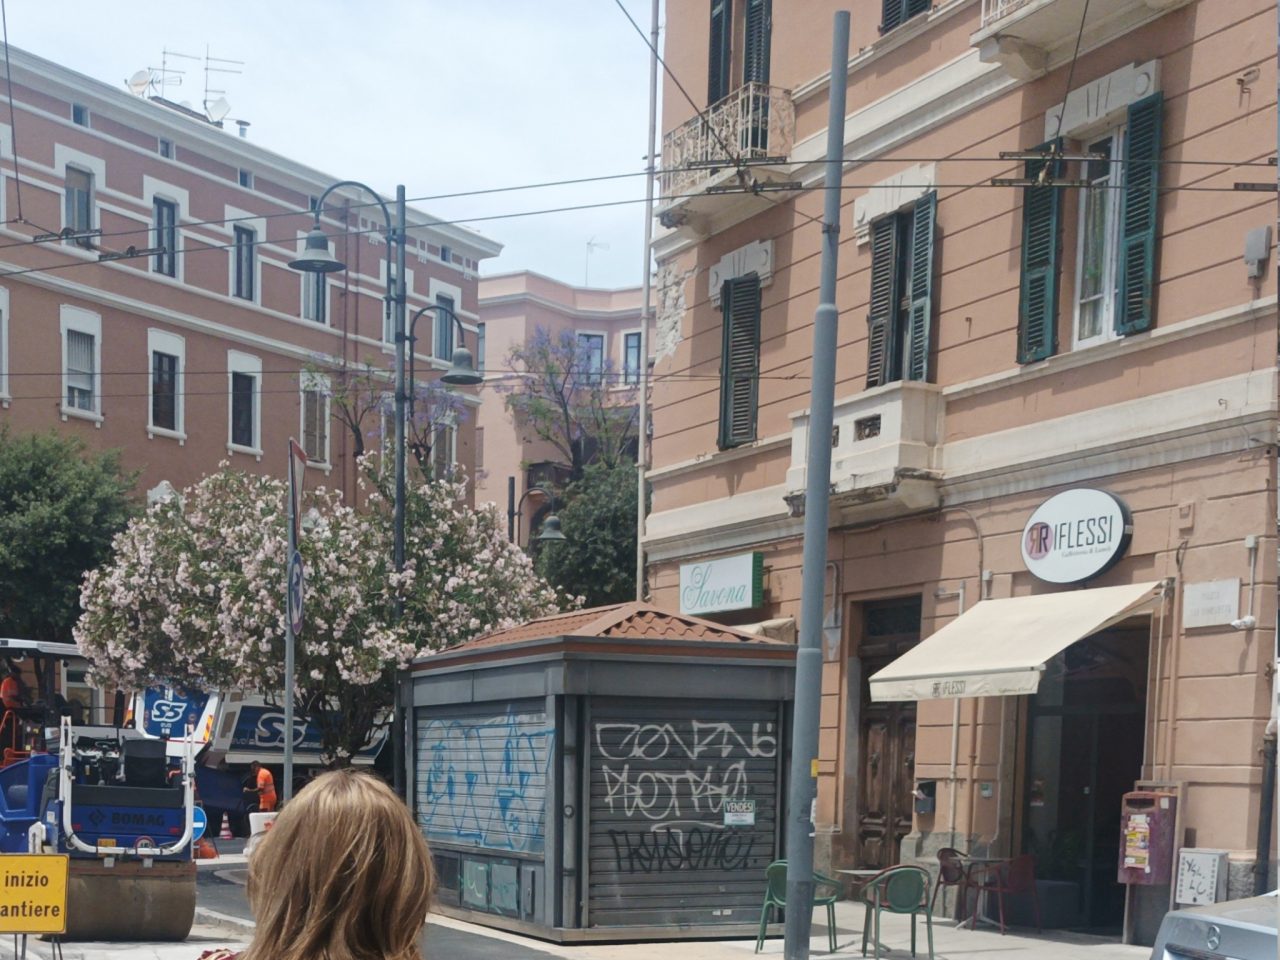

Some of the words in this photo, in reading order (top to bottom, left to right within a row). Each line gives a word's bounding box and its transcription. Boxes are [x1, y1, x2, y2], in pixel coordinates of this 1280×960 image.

[683, 564, 746, 610] Savona
[111, 812, 165, 826] BOMAG
[5, 870, 48, 887] inizio
